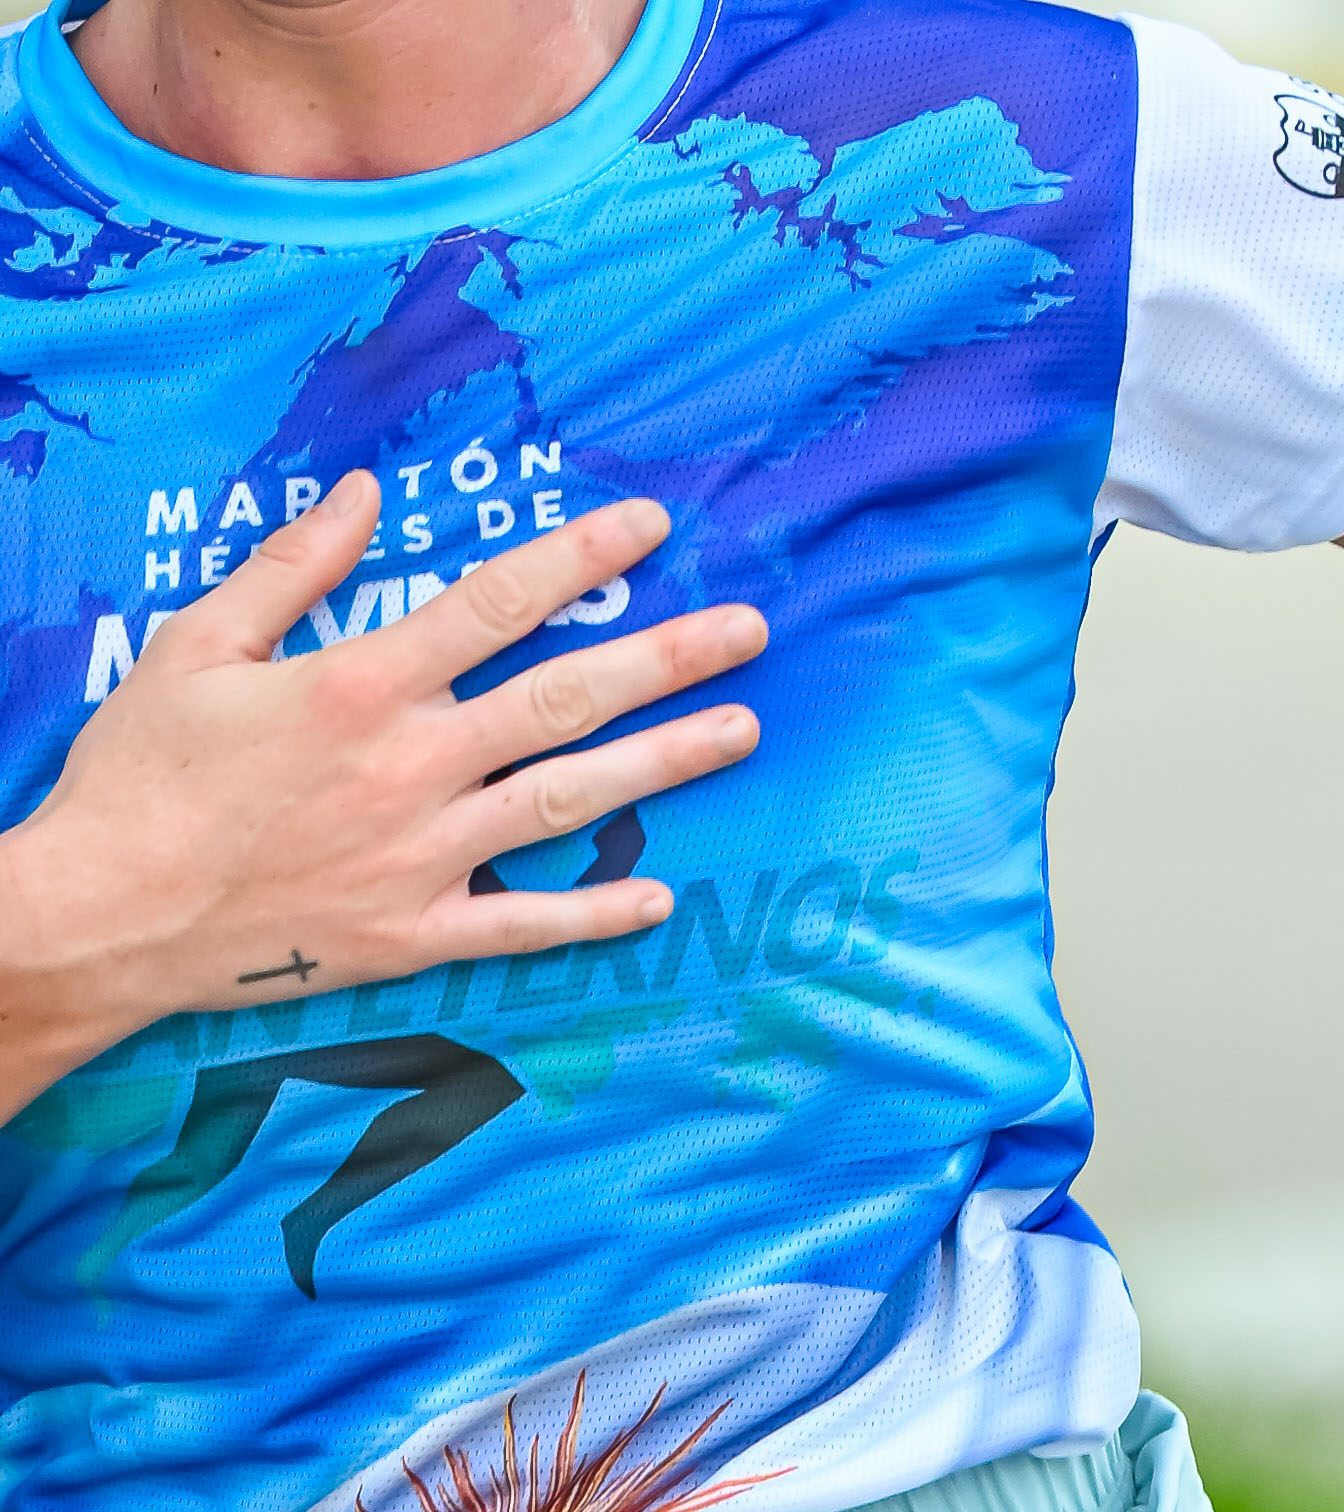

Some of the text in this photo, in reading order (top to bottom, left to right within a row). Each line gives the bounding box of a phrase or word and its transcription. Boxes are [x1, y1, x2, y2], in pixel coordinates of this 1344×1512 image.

[145, 438, 562, 536] MARTÓN
[145, 489, 566, 590] HÉES DE
[84, 560, 631, 704] MVIS
